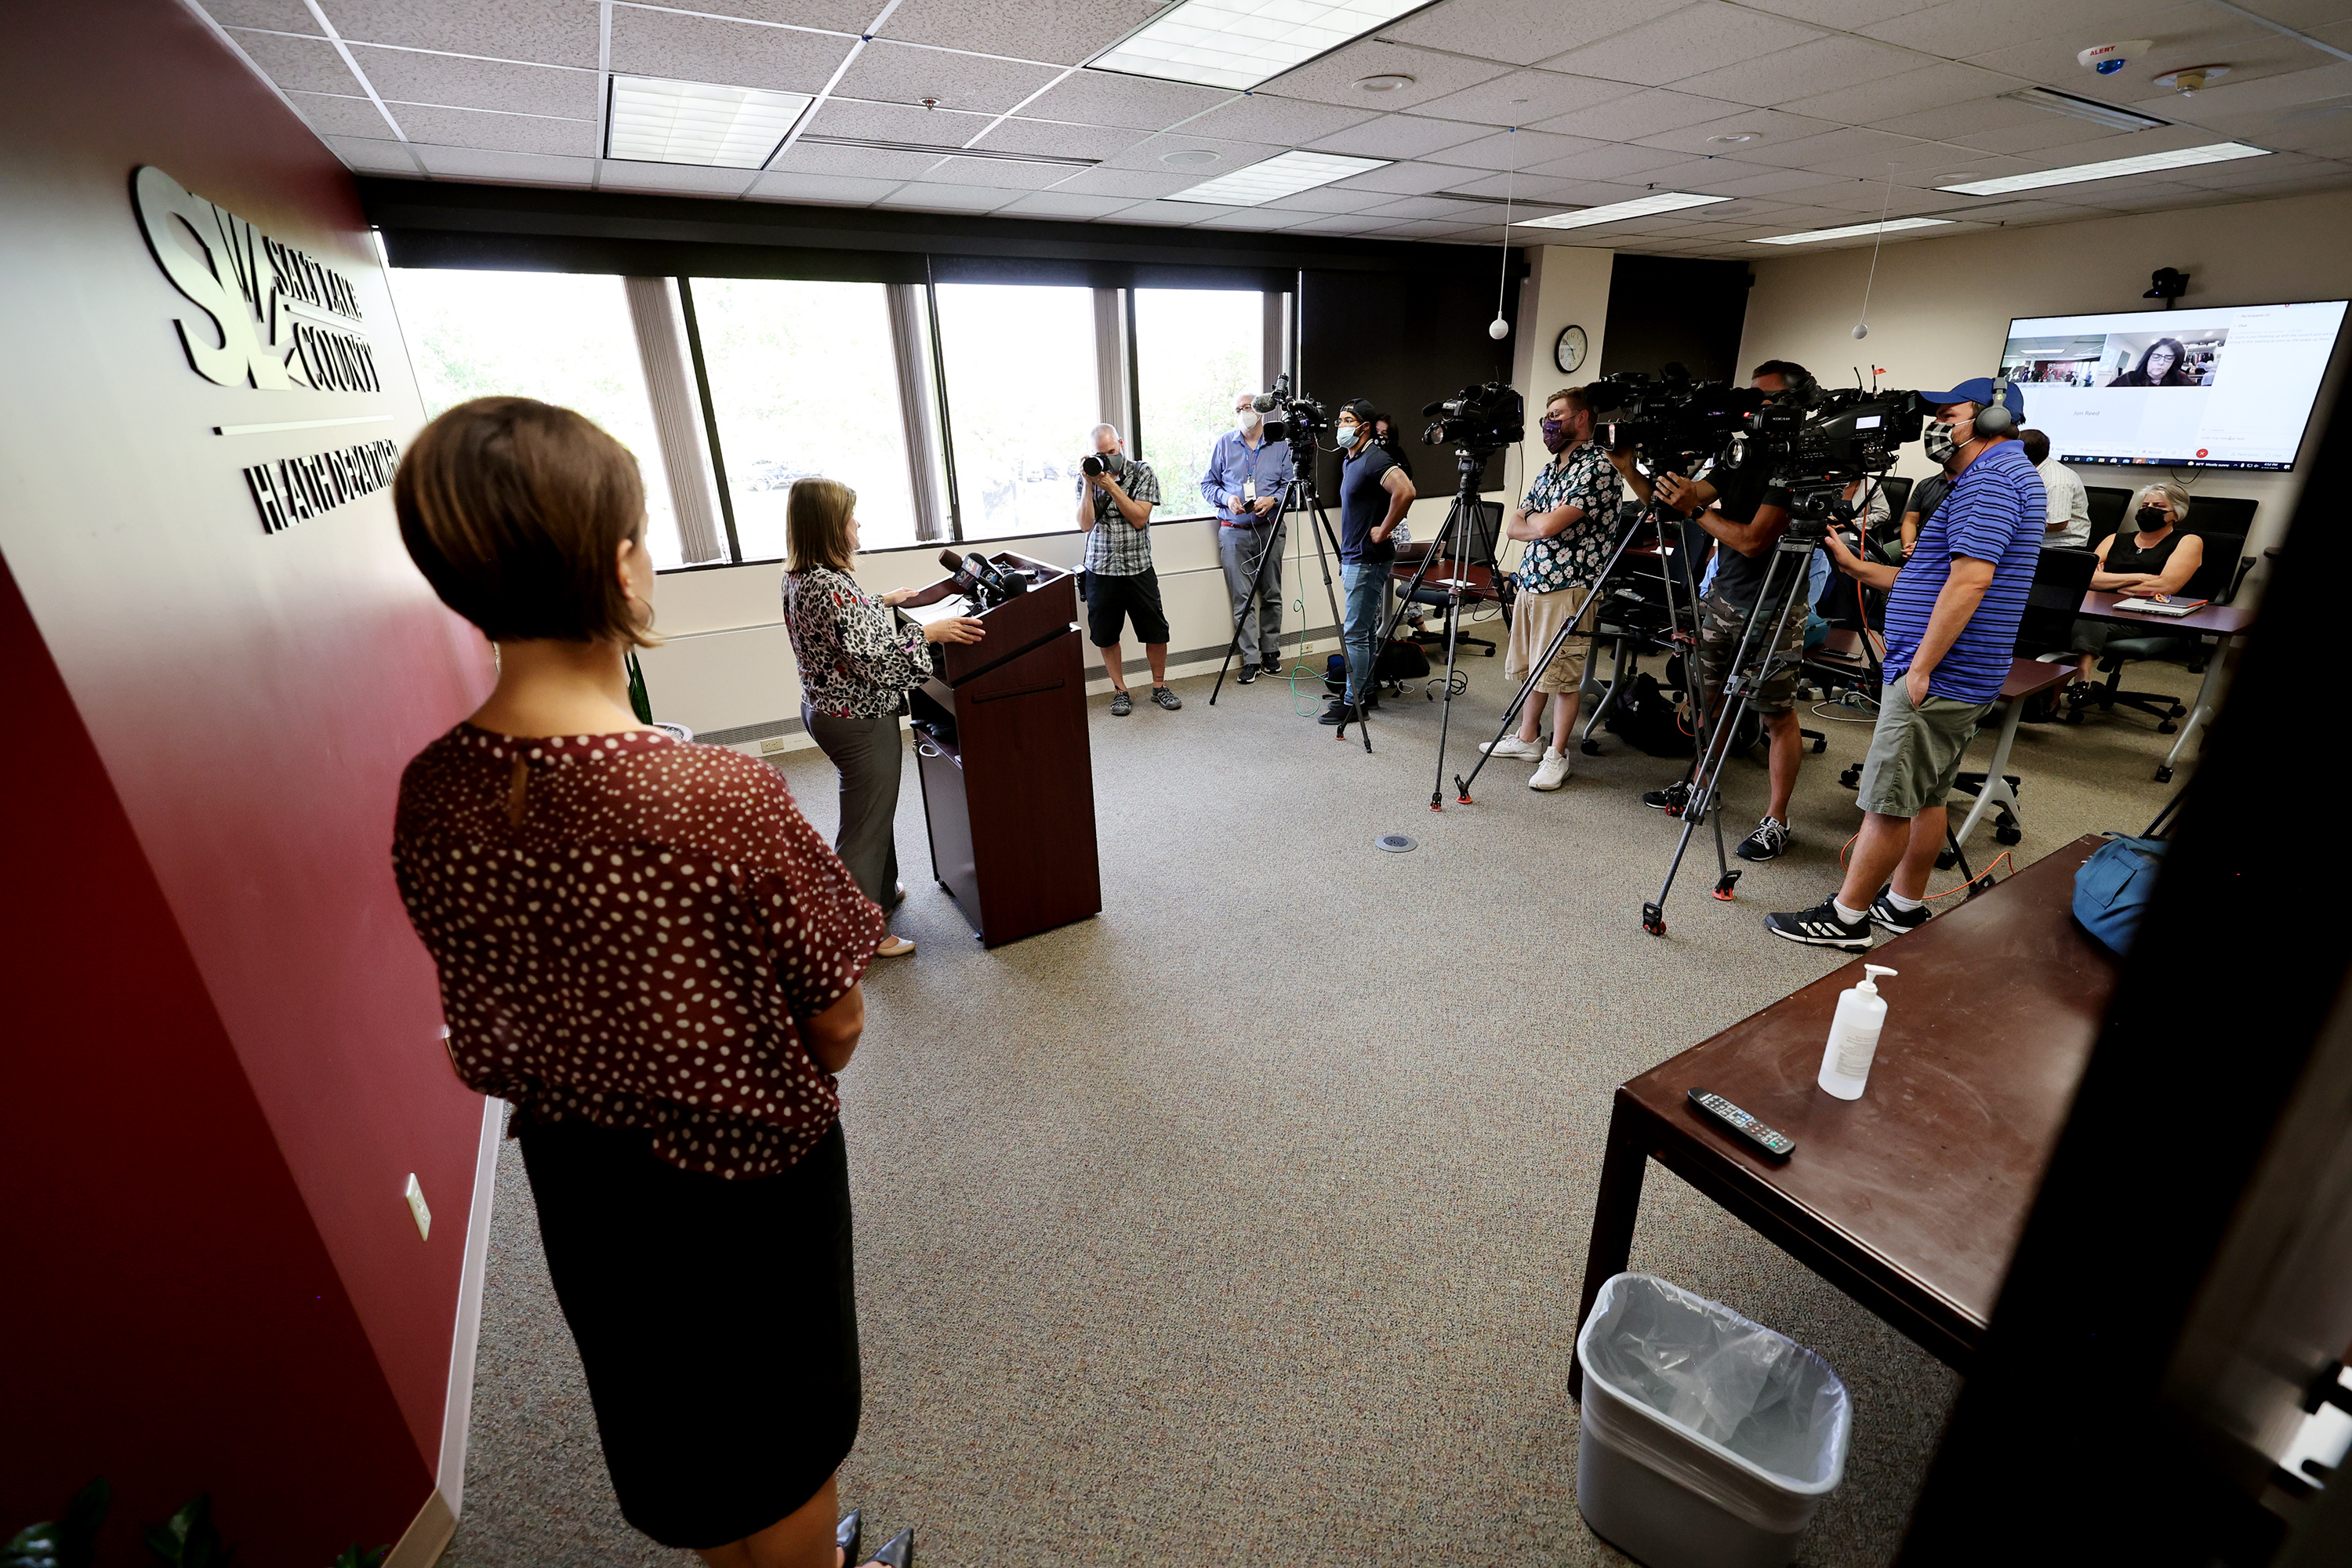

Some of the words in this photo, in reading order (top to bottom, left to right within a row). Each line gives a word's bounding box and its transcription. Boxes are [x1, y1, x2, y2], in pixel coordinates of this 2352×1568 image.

[2090, 45, 2115, 56] ALERT
[263, 235, 326, 308] SALT
[326, 268, 364, 323] LAKE
[293, 322, 382, 392] COUNTY
[243, 455, 337, 535] HEALTH
